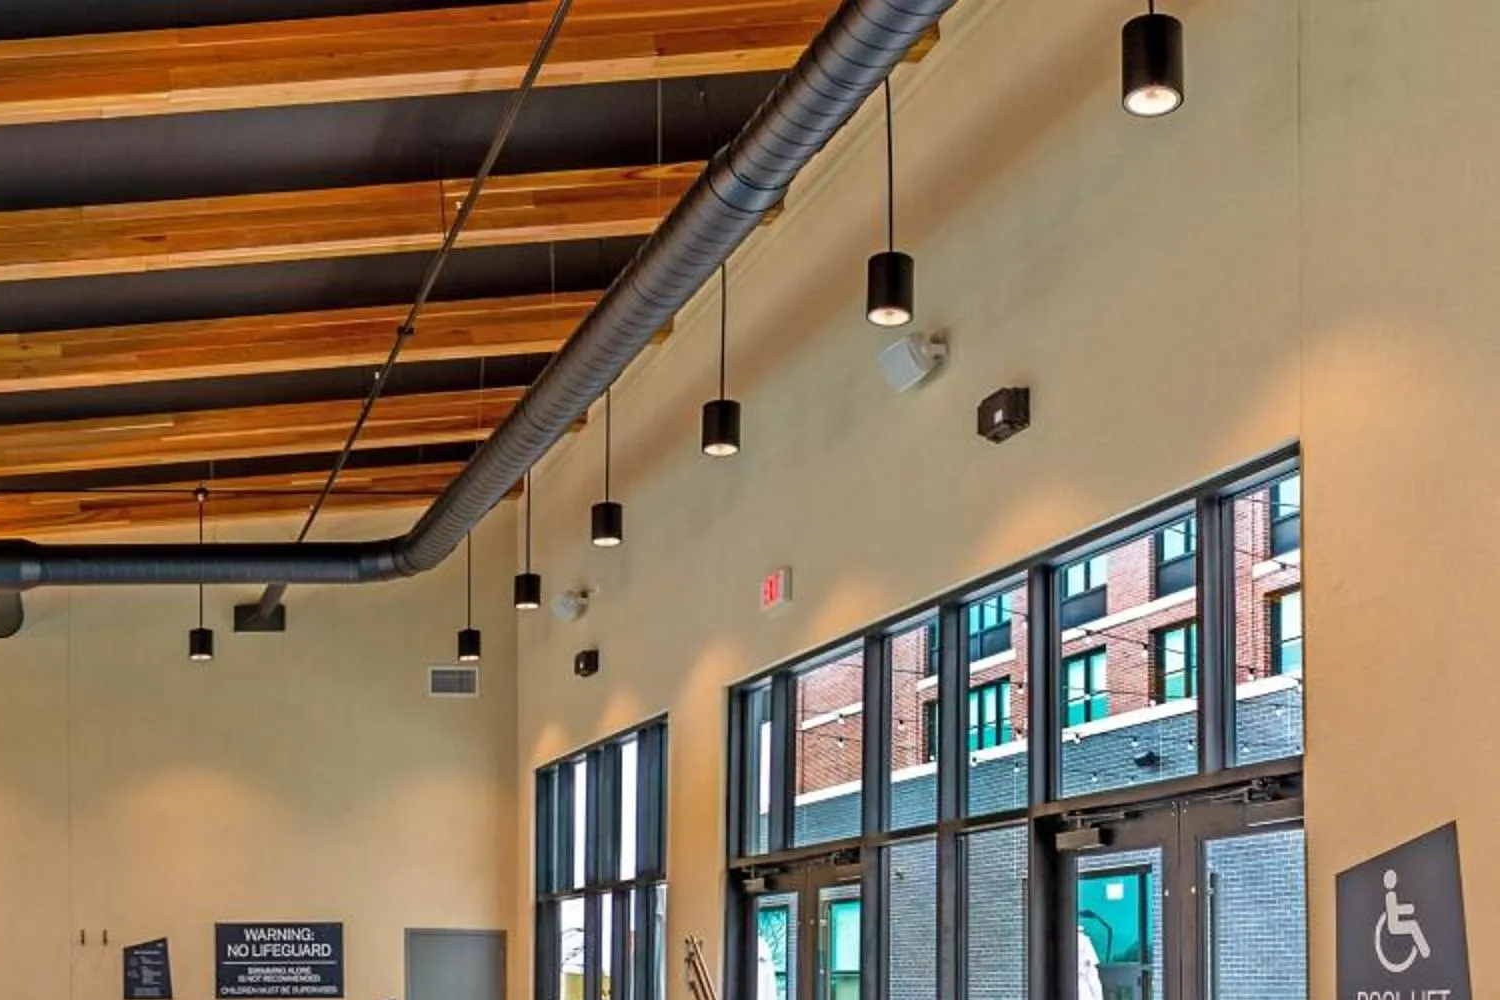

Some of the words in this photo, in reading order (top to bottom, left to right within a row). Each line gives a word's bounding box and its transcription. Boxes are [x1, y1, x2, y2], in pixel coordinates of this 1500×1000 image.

[244, 927, 315, 941] WARNING:
[227, 943, 250, 957] NO
[252, 943, 332, 957] LIFEGUARD
